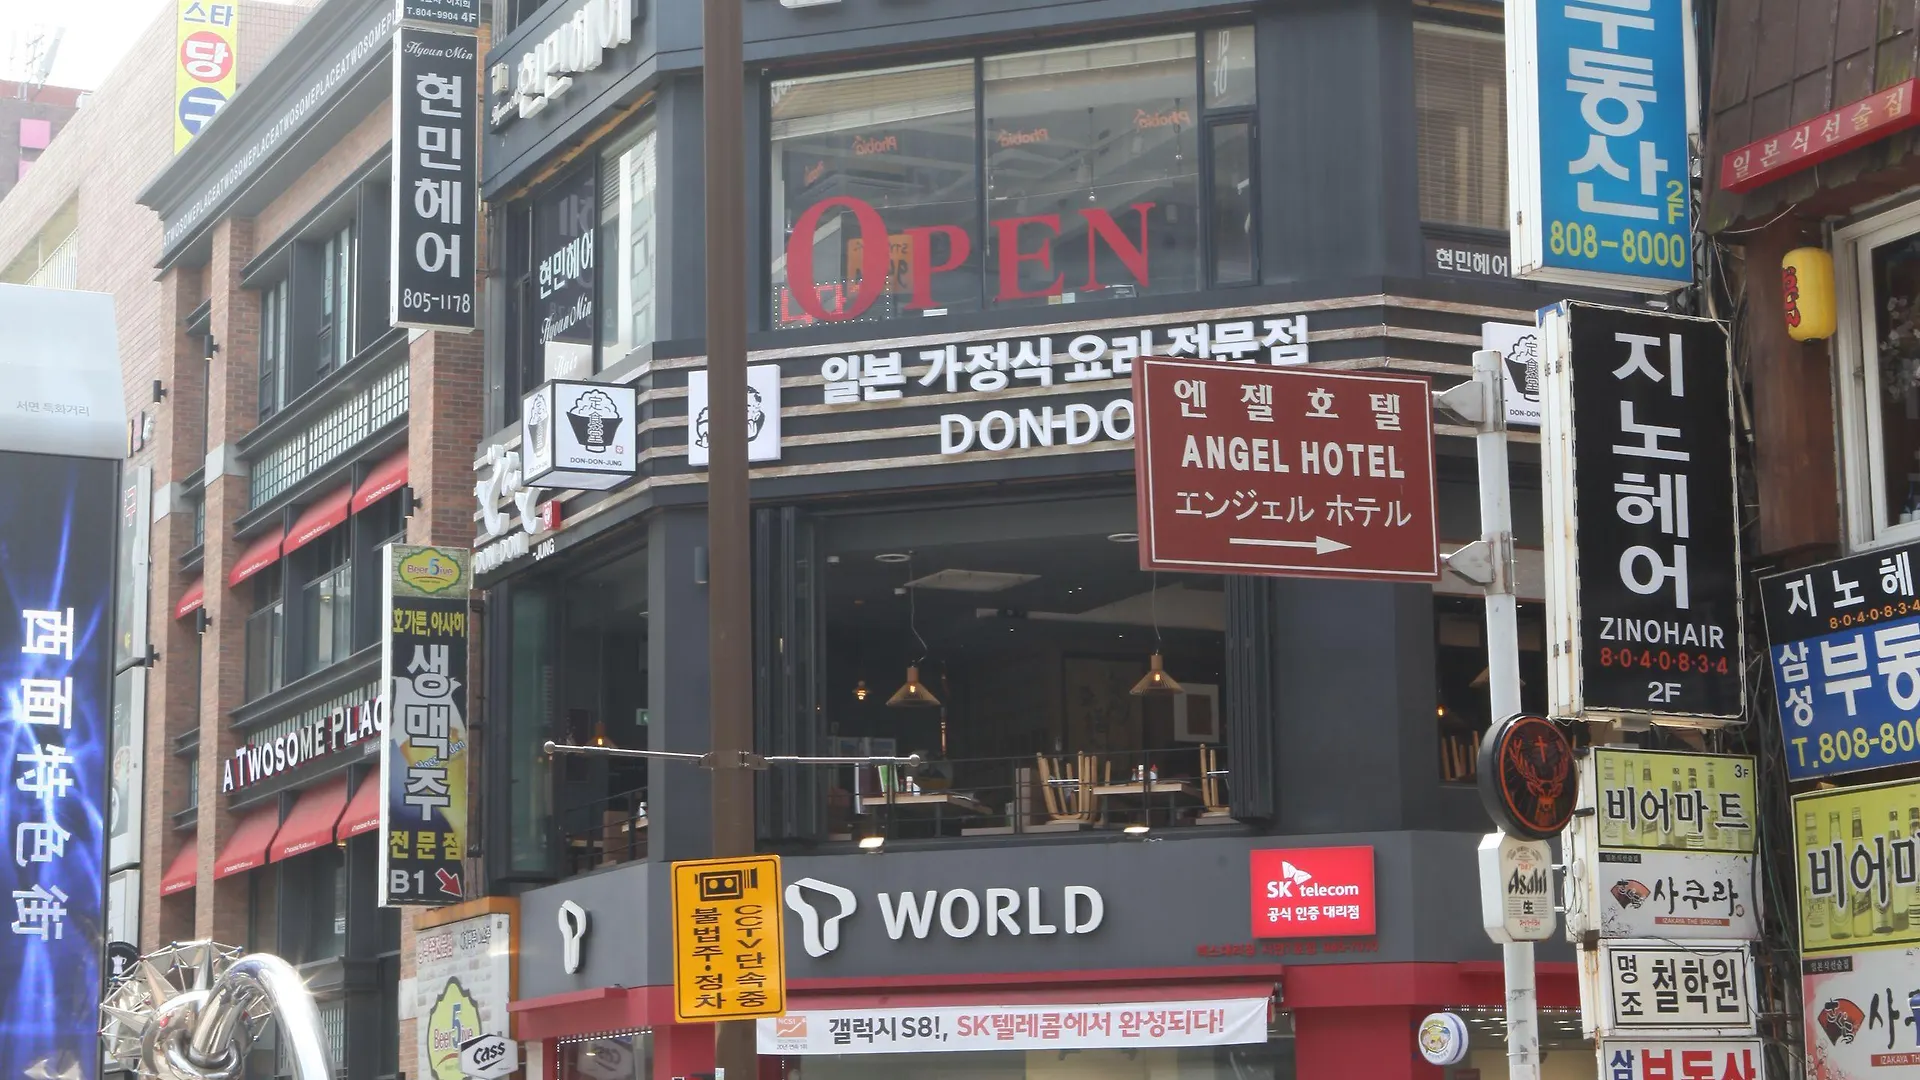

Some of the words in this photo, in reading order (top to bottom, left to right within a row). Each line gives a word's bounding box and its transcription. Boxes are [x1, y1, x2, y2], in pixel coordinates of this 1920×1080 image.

[184, 2, 234, 27] 스타
[406, 7, 458, 20] T.804-9904
[461, 12, 477, 23] 4F
[404, 41, 442, 57] Hyoun
[445, 47, 473, 60] Min
[415, 73, 463, 278] 현민헤어
[786, 195, 1156, 323] OPEN
[1550, 220, 1685, 268] 808-8000
[539, 229, 593, 299] 현민헤어
[1436, 248, 1508, 277] 현민헤어
[403, 288, 470, 314] 805-1178
[568, 293, 592, 326] Min
[821, 351, 906, 404] 일본
[919, 332, 1053, 394] 가정식
[1064, 328, 1153, 382] 요리
[17, 401, 40, 413] 서면
[570, 457, 622, 467] DON-DON-JUNG
[1181, 434, 1289, 473] ANGEL
[1300, 440, 1405, 479] HOTEL
[1612, 332, 1690, 610] 지노헤어
[1175, 489, 1315, 522] エンジェル
[1326, 494, 1412, 527] ホテル
[1600, 617, 1725, 649] ZINOHAIR
[1648, 681, 1681, 703] 2F
[1779, 641, 1814, 727] 삼성
[405, 643, 449, 822] 생맥주
[1791, 719, 1920, 768] T.808-80
[223, 759, 234, 793] A
[236, 718, 326, 787] TWOSOME
[1734, 764, 1749, 778] 3F
[11, 607, 75, 941] 西面特色街
[1605, 786, 1749, 833] 비어마트
[390, 830, 461, 860] 전문점
[391, 869, 425, 894] B1
[1267, 881, 1292, 898] SK
[1300, 882, 1359, 897] telecom
[1508, 867, 1547, 895] Asahi
[1653, 877, 1739, 917] 사쿠라
[877, 886, 1105, 940] WORLD
[1268, 908, 1291, 922] 공식
[1296, 907, 1320, 921] 인증
[1323, 905, 1360, 920] 대리점
[1523, 900, 1534, 914] 生
[734, 904, 767, 1008] CCTV단속중
[1617, 955, 1643, 1016] 명조
[1652, 958, 1740, 1014] 철학원
[829, 1017, 897, 1045] 갤럭시
[901, 1016, 948, 1042] S8!,
[957, 1012, 1111, 1041] SK텔레콤에서
[1118, 1009, 1224, 1037] 완성되다!
[1880, 1055, 1908, 1064] IZAKAYA
